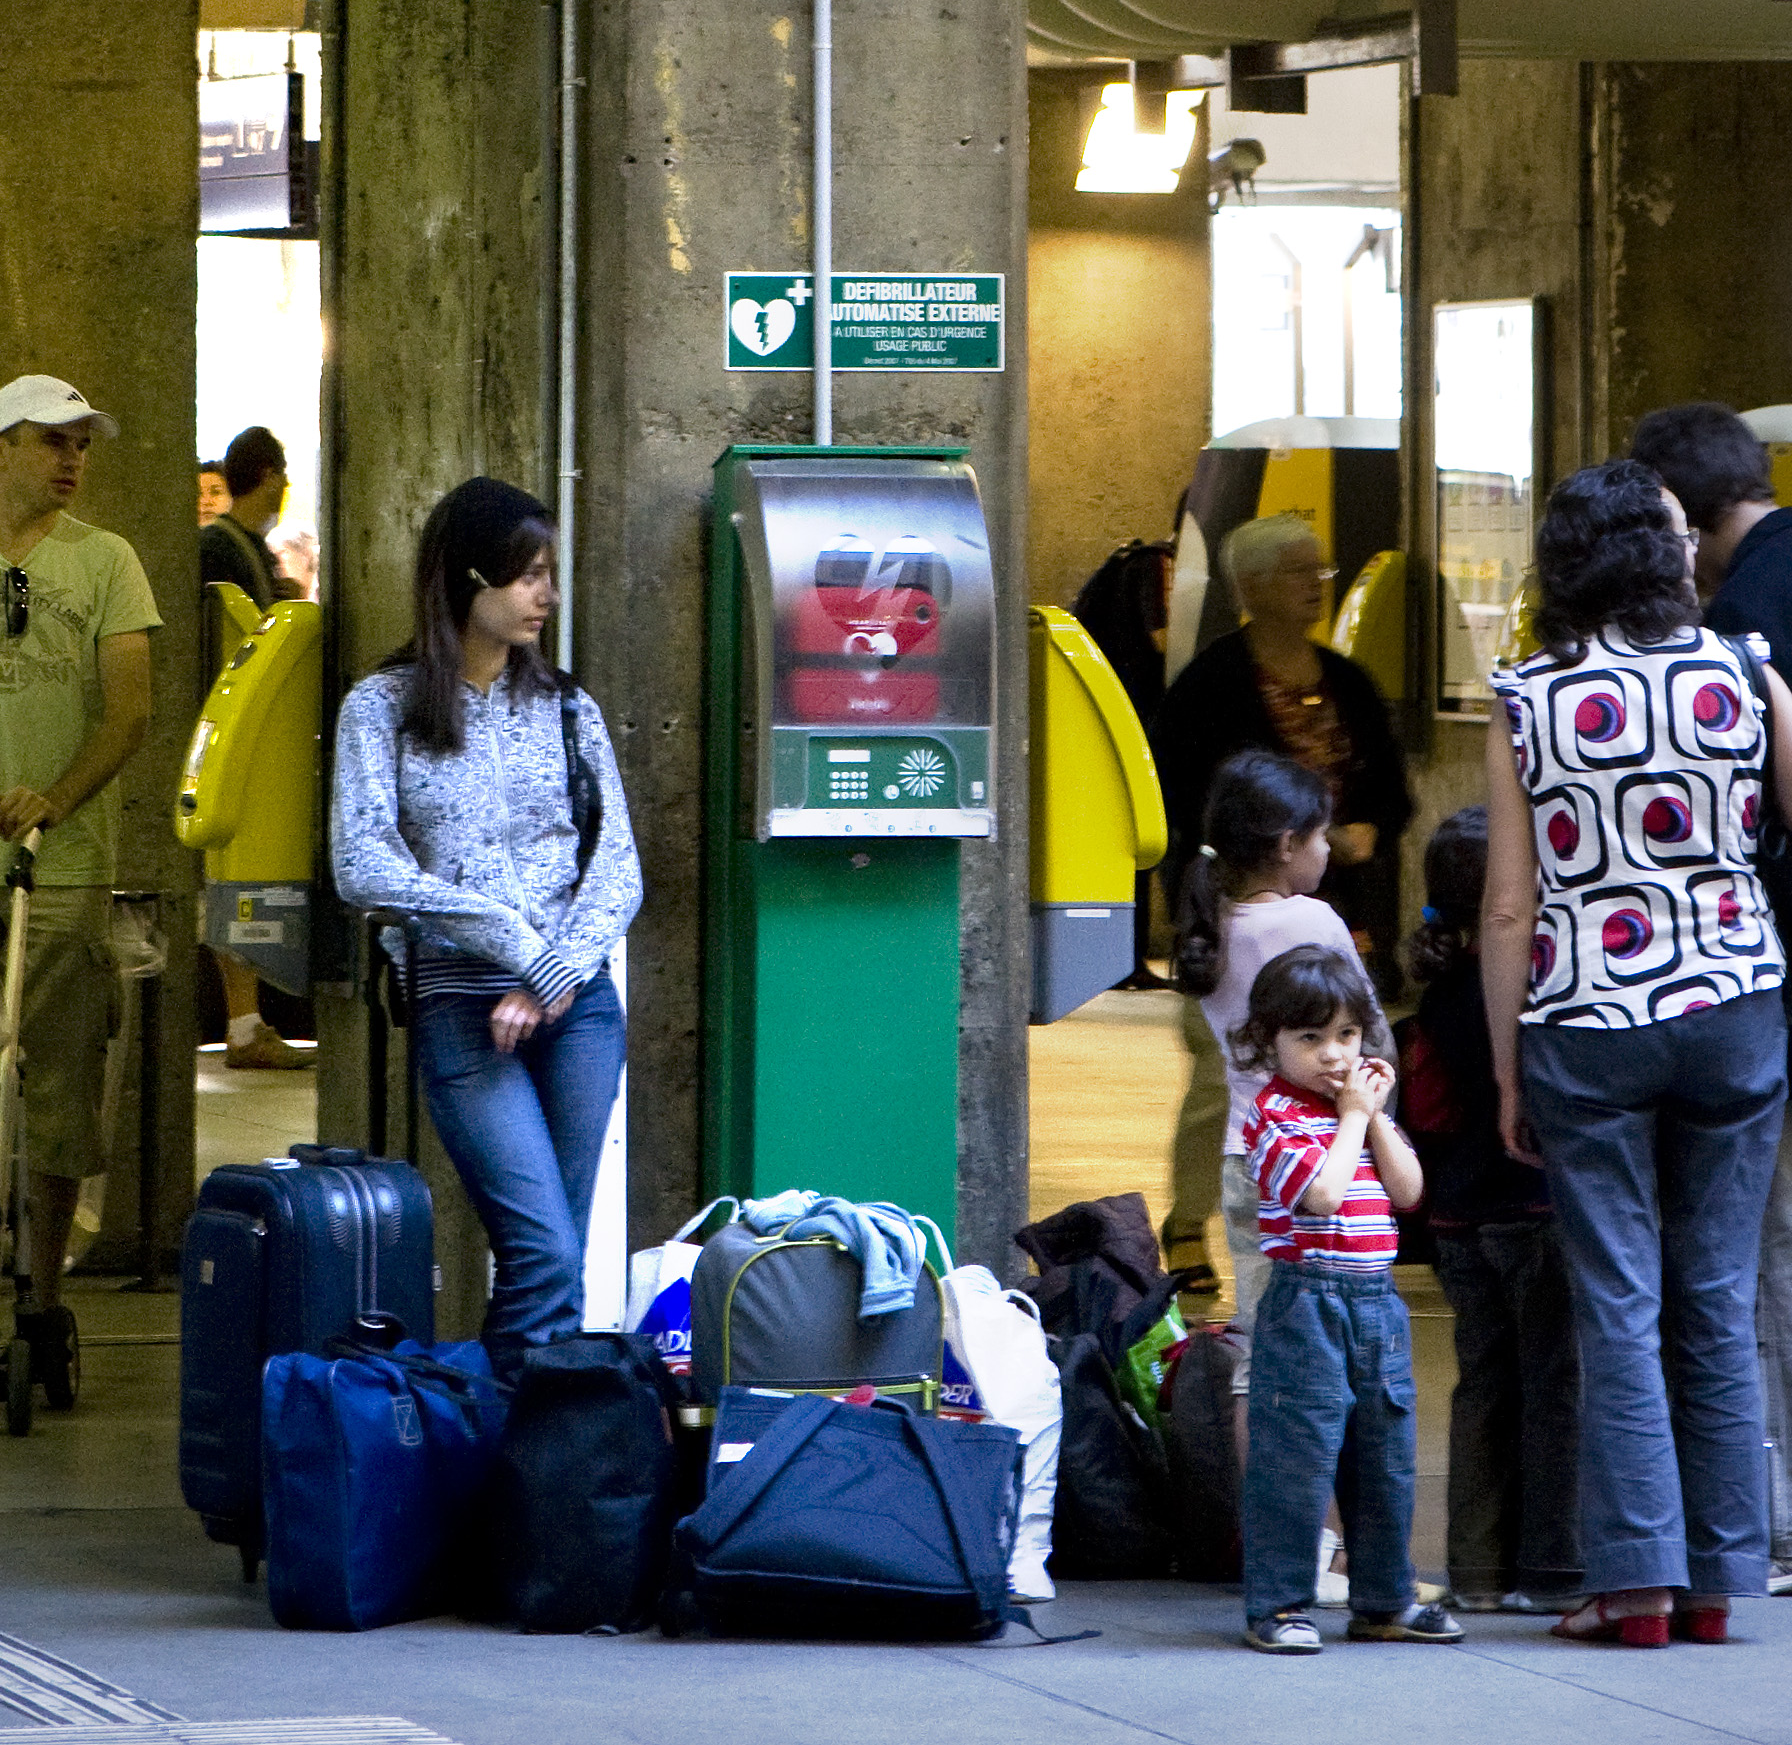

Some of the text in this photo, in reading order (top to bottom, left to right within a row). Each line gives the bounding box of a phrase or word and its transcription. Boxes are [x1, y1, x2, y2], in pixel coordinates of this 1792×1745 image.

[844, 282, 978, 302] DEFIBRILLATEUR
[928, 303, 1001, 323] EXTERNE
[845, 327, 890, 339] UTILISER
[891, 327, 906, 339] EN
[908, 327, 929, 339] CAS
[929, 327, 987, 339] D'URGENCE
[873, 340, 948, 353] USAGE PUBLIC
